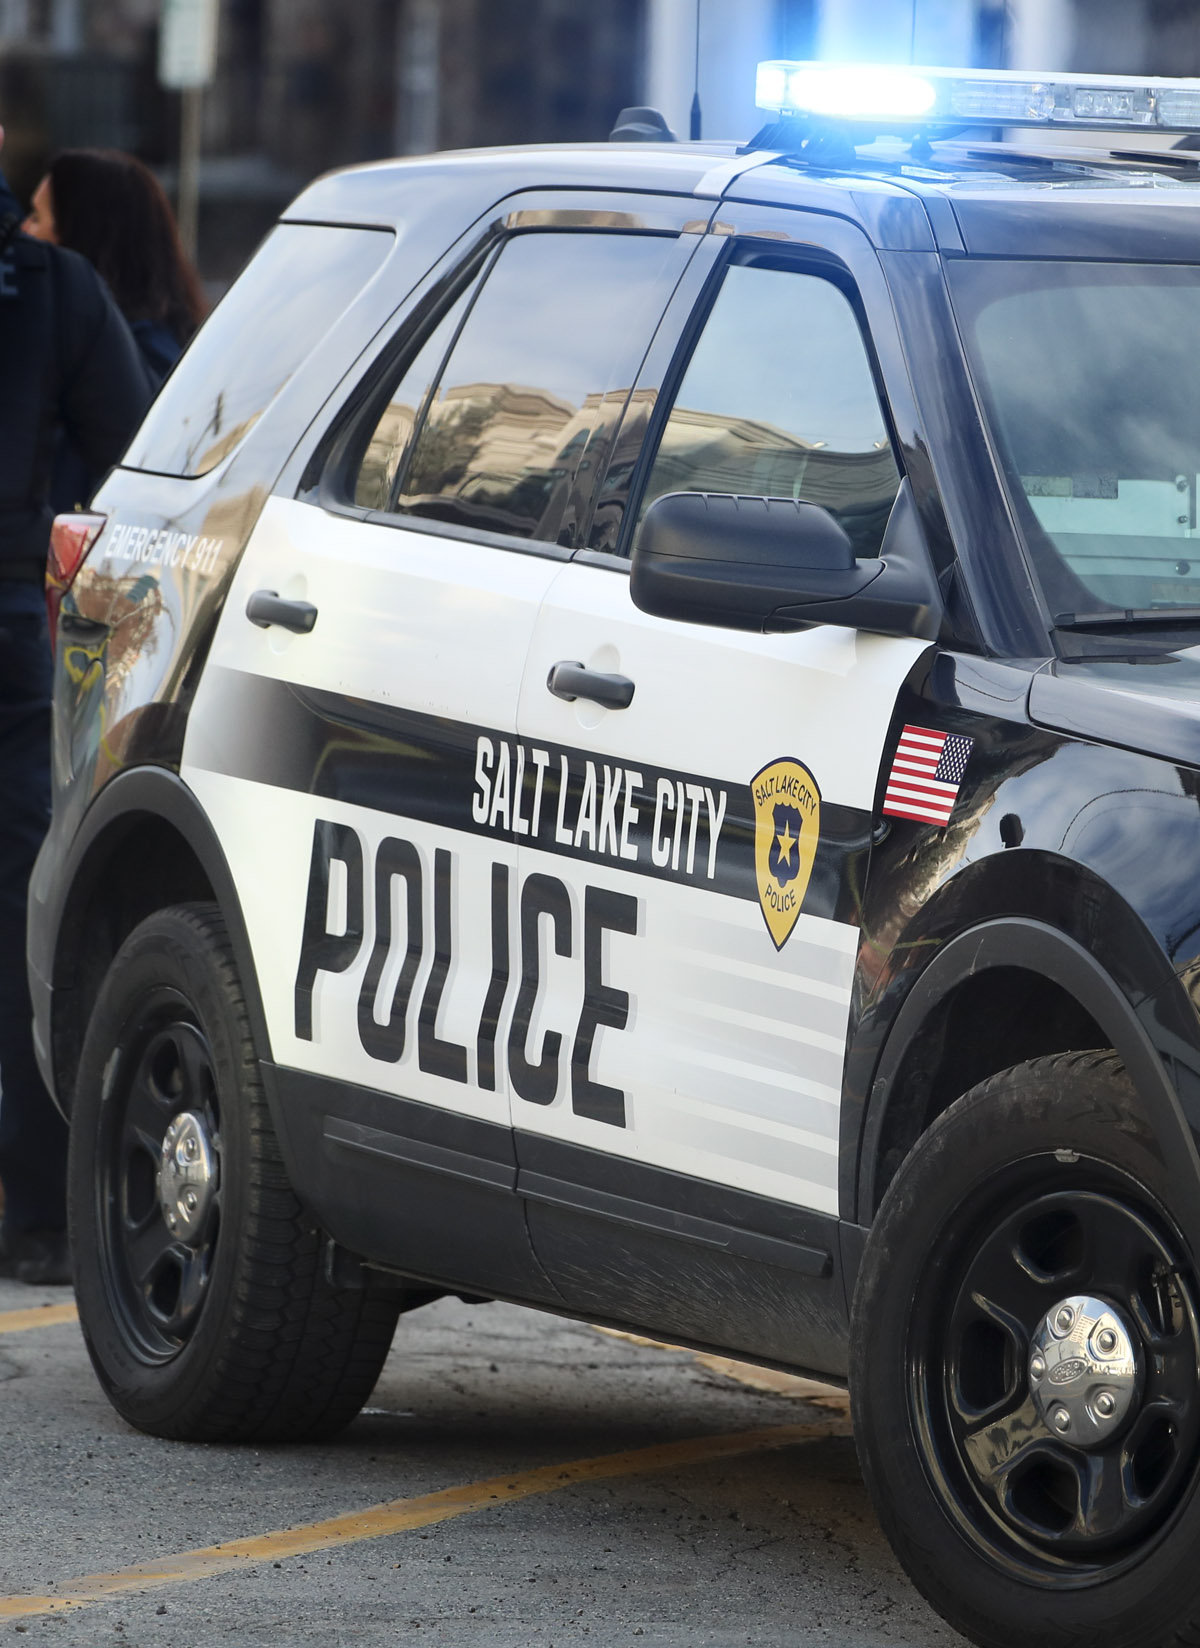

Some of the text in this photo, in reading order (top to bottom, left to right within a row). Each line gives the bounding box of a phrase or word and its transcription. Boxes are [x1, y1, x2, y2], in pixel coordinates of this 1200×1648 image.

[104, 524, 224, 573] EMERGENCY 911
[472, 736, 728, 880] SALT LAKE CITY
[755, 774, 817, 817] SALT LAKE CITY
[764, 883, 797, 913] POLICE
[294, 818, 639, 1129] POLICE
